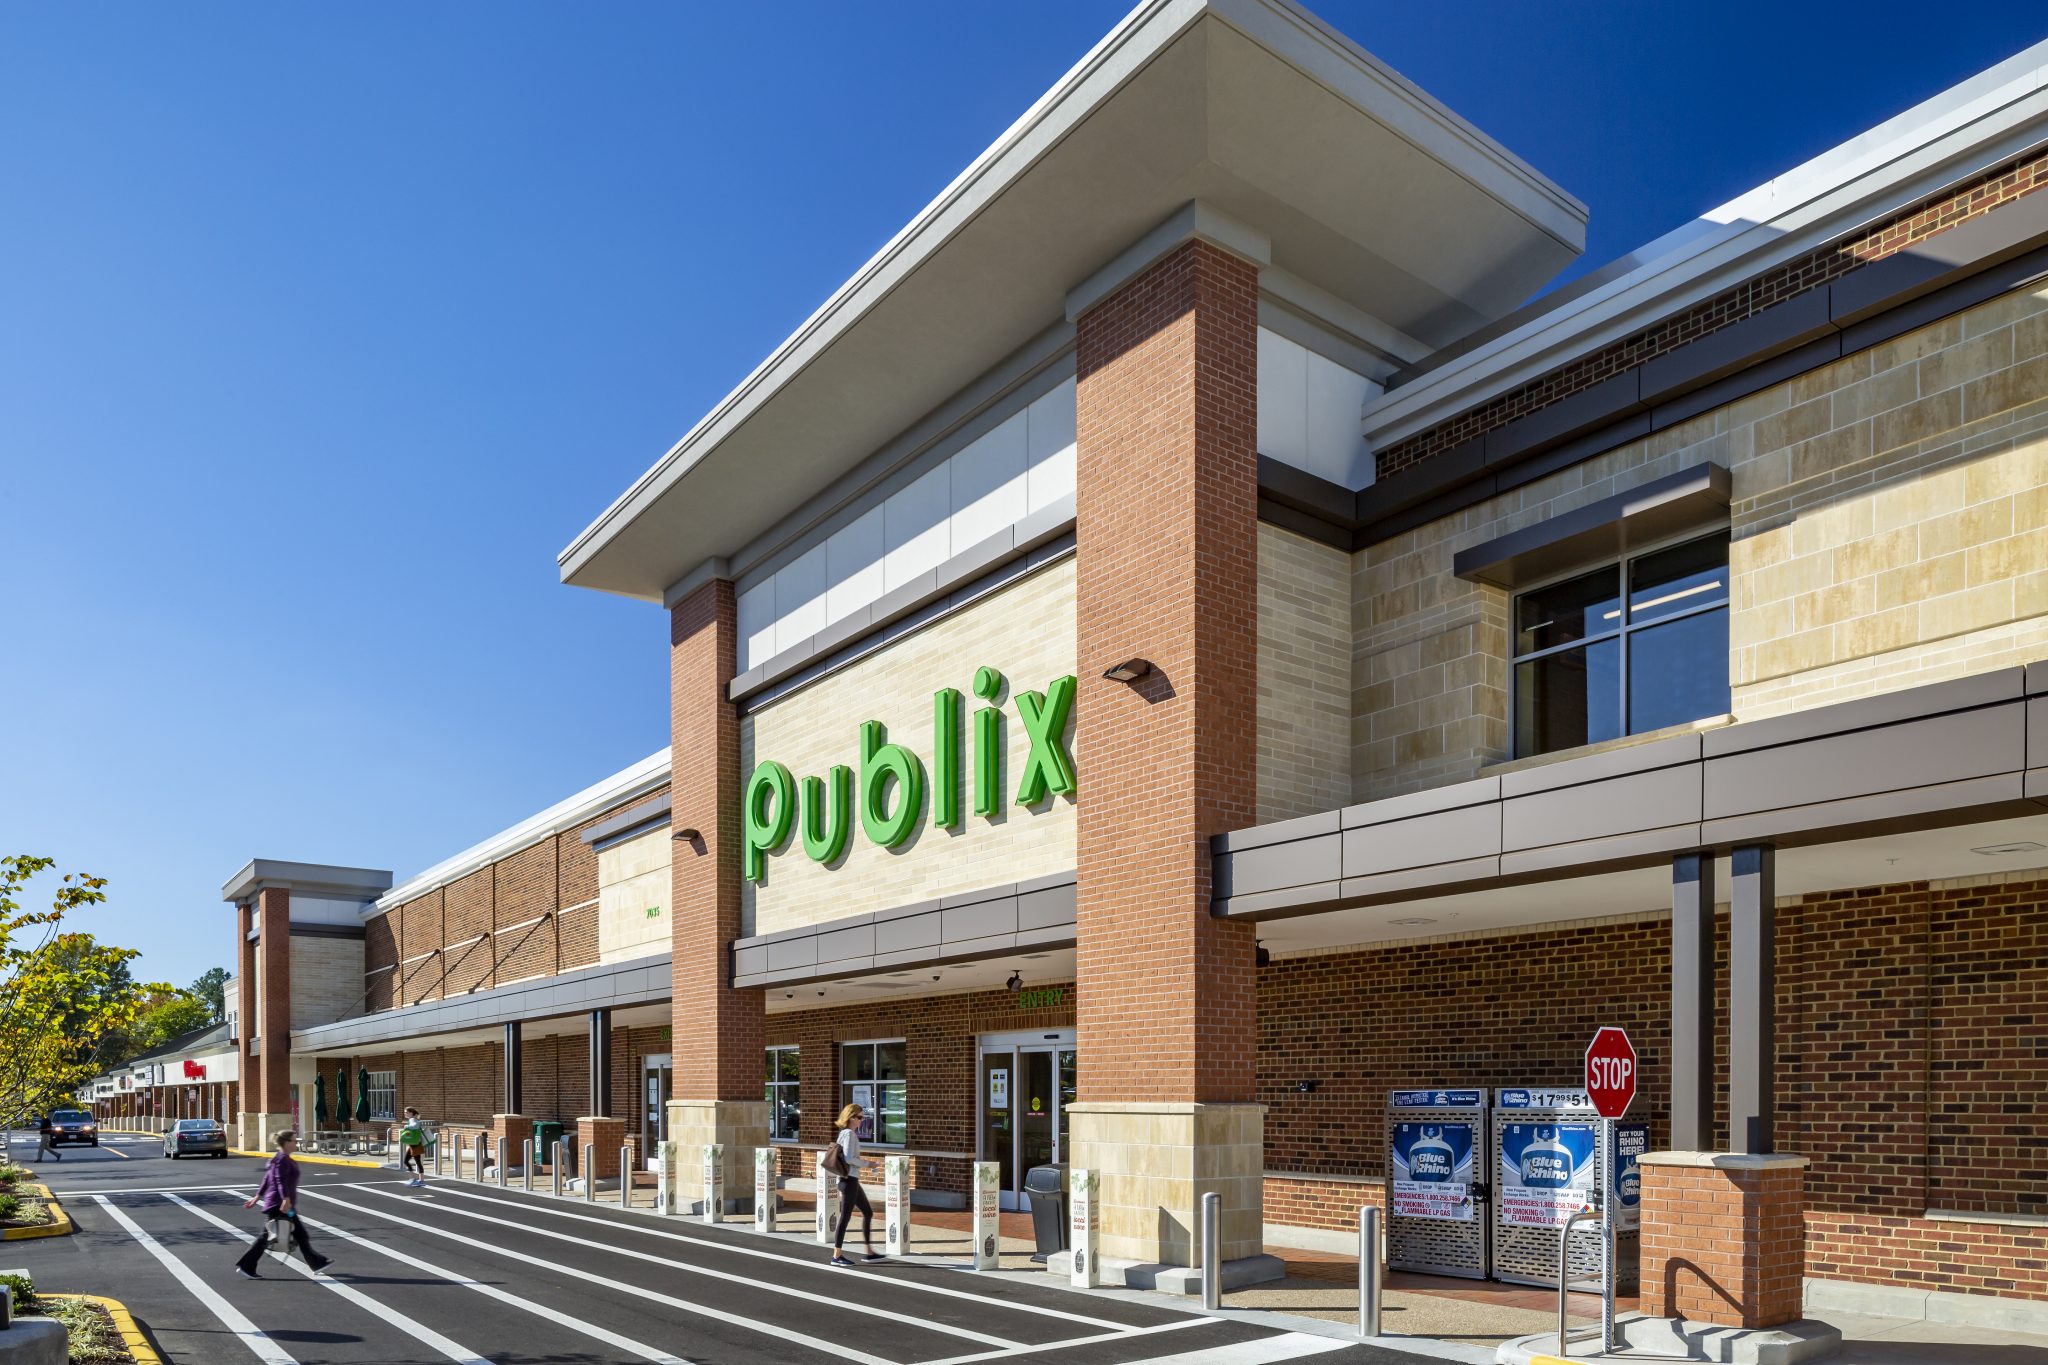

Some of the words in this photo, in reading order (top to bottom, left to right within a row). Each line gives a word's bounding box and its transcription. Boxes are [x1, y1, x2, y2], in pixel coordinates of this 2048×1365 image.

[745, 665, 1077, 881] publix
[1019, 989, 1064, 1009] ENTRY
[1590, 1056, 1632, 1090] STOP
[1619, 1137, 1644, 1146] RHINO
[1619, 1145, 1645, 1156] HERE!
[1418, 1152, 1445, 1164] Blue
[1532, 1156, 1563, 1168] Blue
[1416, 1163, 1450, 1175] Rhino
[1529, 1167, 1568, 1180] Rhino
[1401, 1207, 1431, 1215] FLAMMABLE
[1513, 1208, 1539, 1216] SMOKING
[1512, 1215, 1547, 1223] FLAMMABLE
